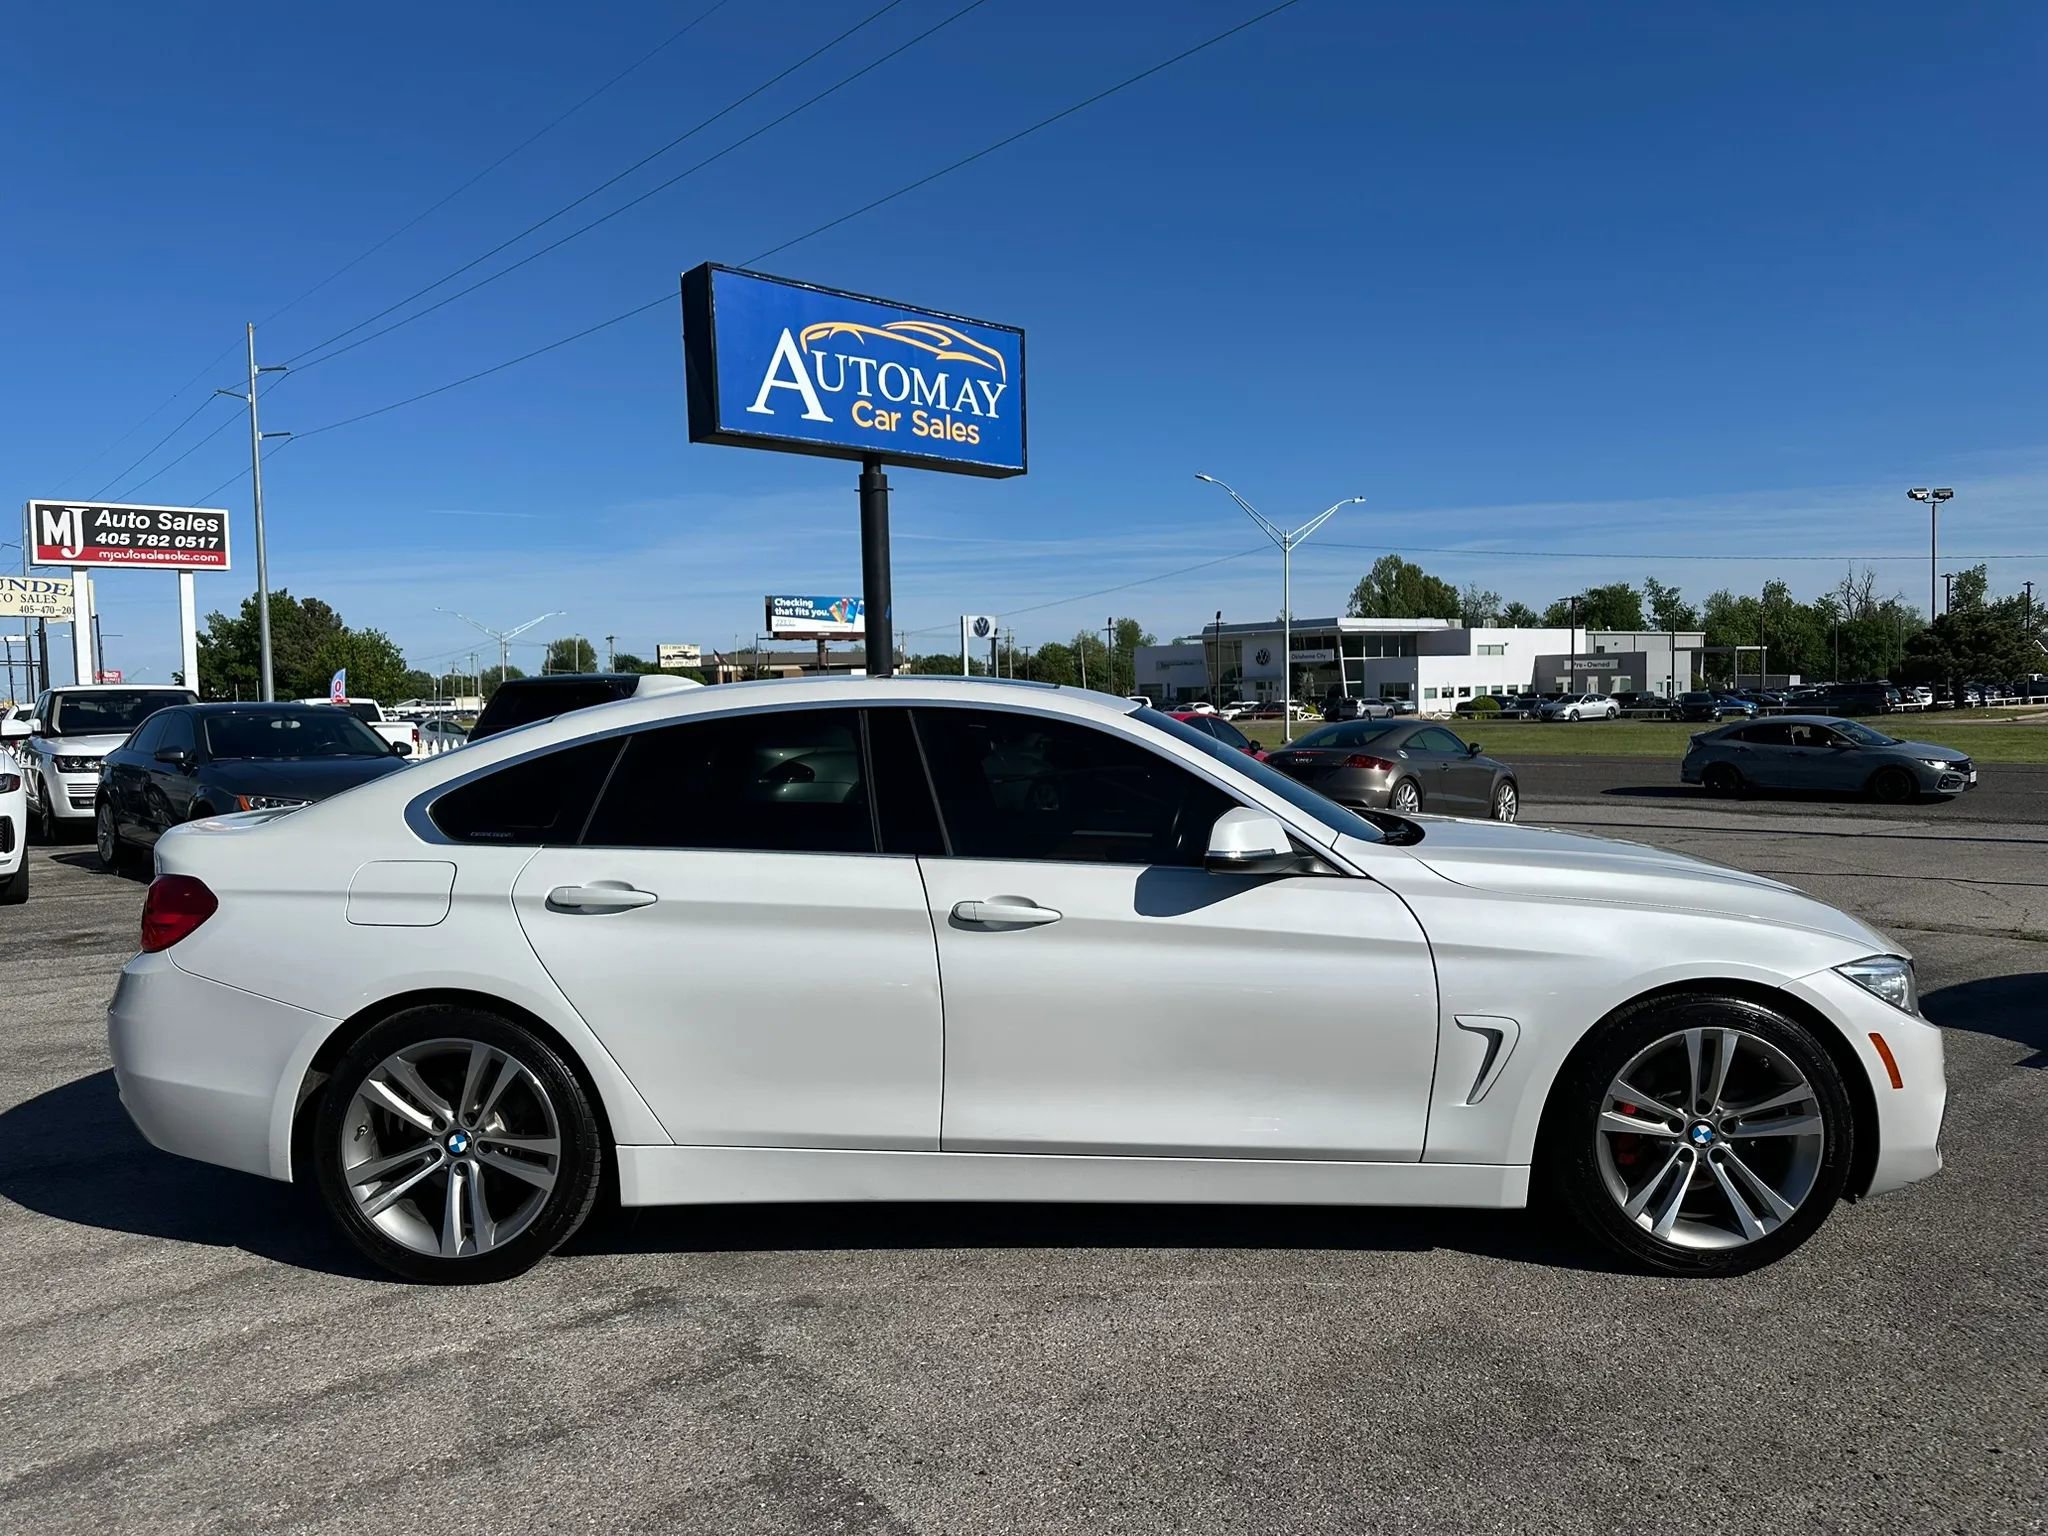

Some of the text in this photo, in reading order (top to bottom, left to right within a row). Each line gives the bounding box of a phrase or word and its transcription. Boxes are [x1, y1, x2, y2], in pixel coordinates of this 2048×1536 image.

[851, 400, 980, 445] Car Sales
[94, 509, 219, 533] Auto Sales
[42, 507, 90, 559] MJ
[95, 532, 219, 549] 405 782 0517
[98, 549, 219, 562] mjautosalesokc.com
[20, 593, 57, 604] SALES
[774, 598, 814, 608] Checking
[774, 607, 830, 618] that fits you.
